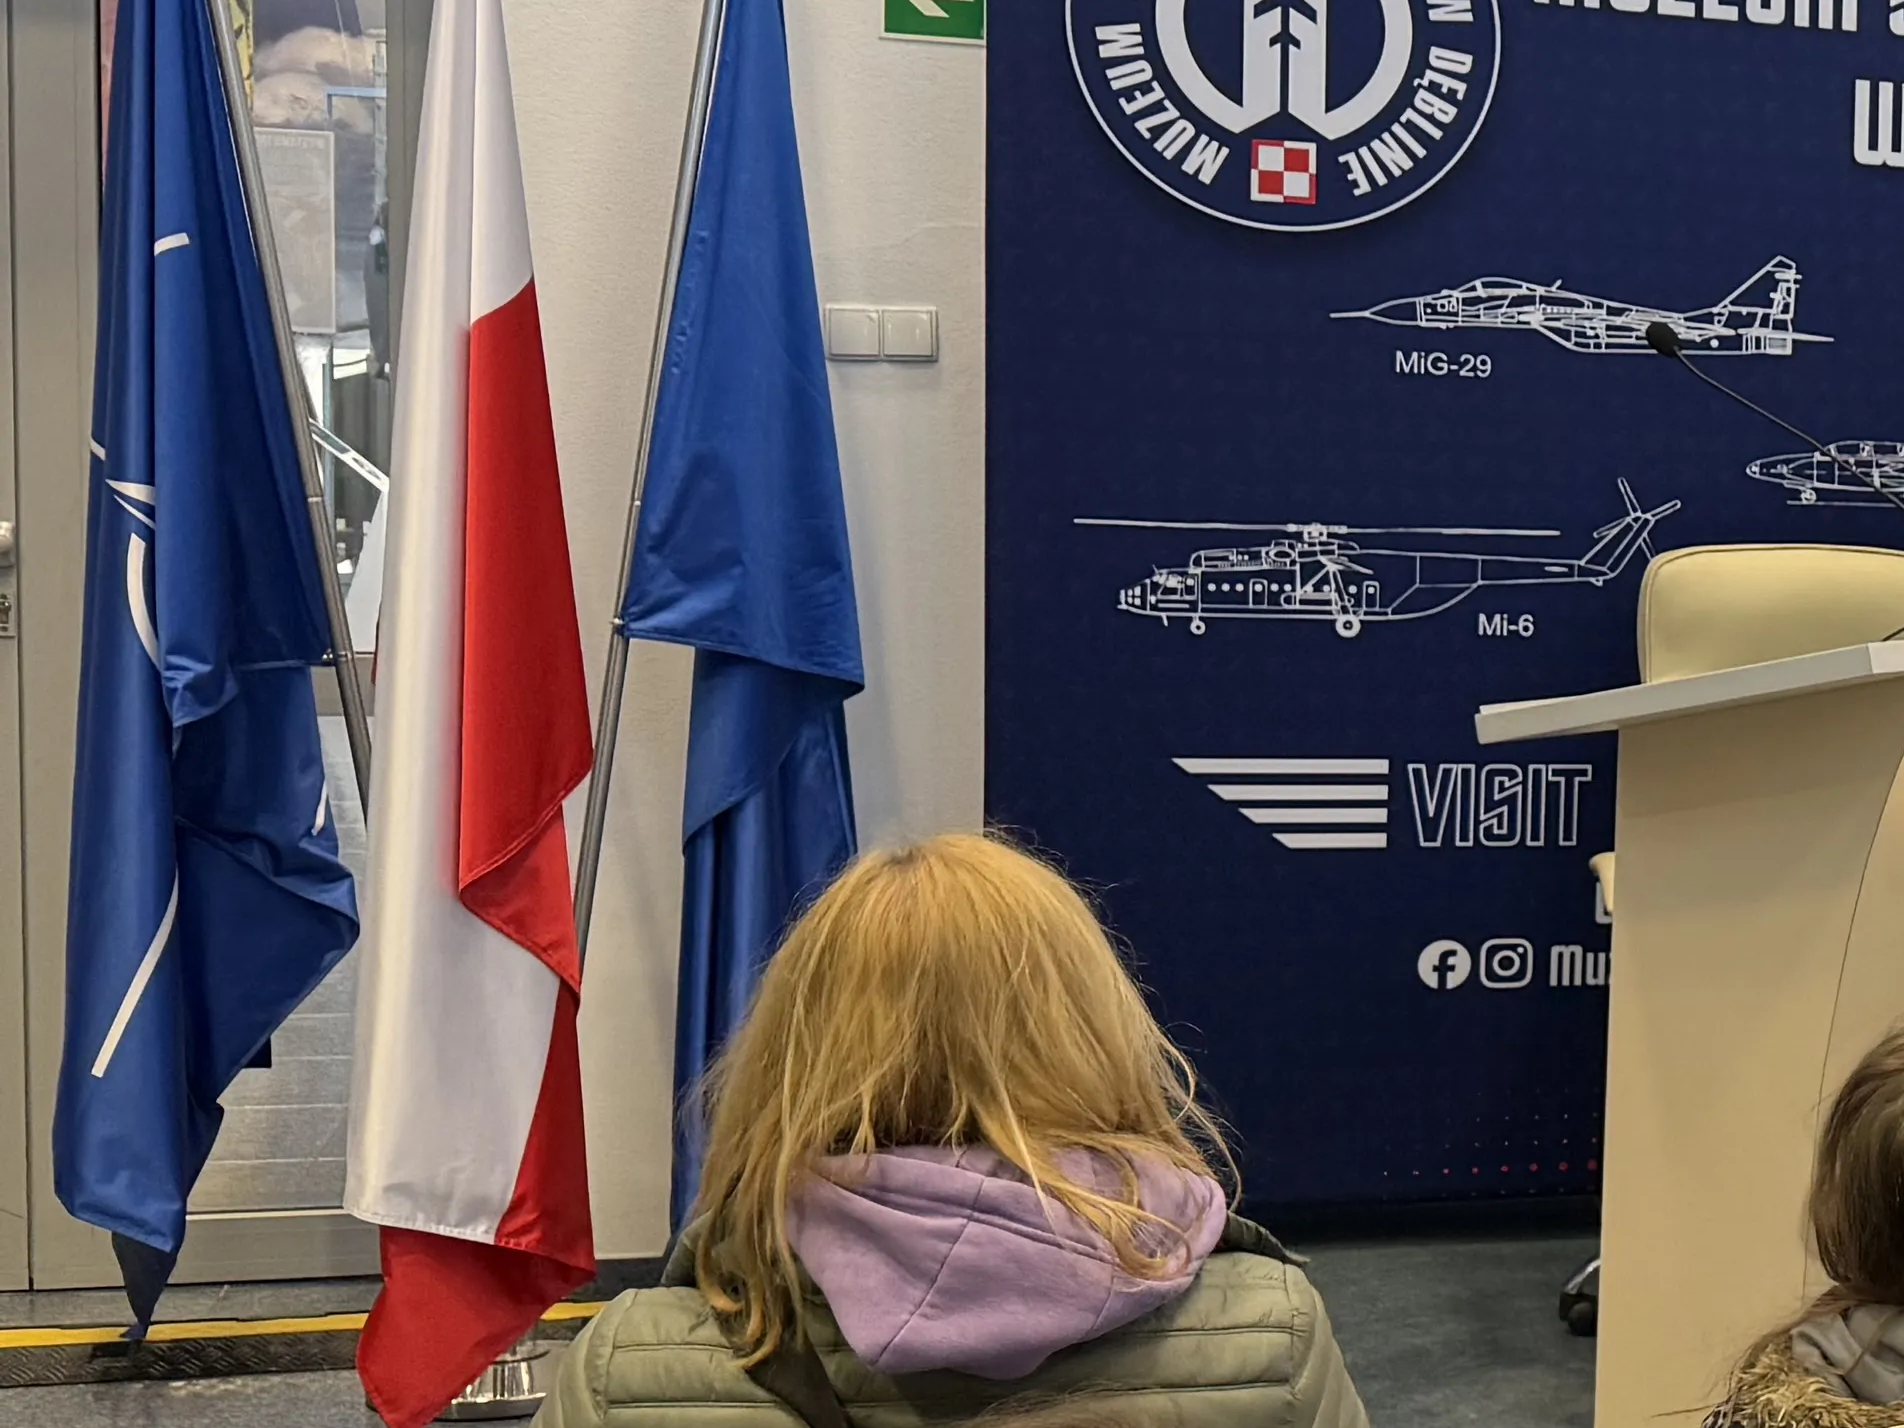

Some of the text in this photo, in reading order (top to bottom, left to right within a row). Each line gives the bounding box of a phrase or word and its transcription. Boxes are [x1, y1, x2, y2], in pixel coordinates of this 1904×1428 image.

[1094, 22, 1230, 185] MUZEUM
[1337, 46, 1474, 197] DĘBLINIE
[1395, 350, 1492, 377] MiG-29
[1477, 612, 1534, 637] Mi-6
[1407, 763, 1592, 847] VISIT
